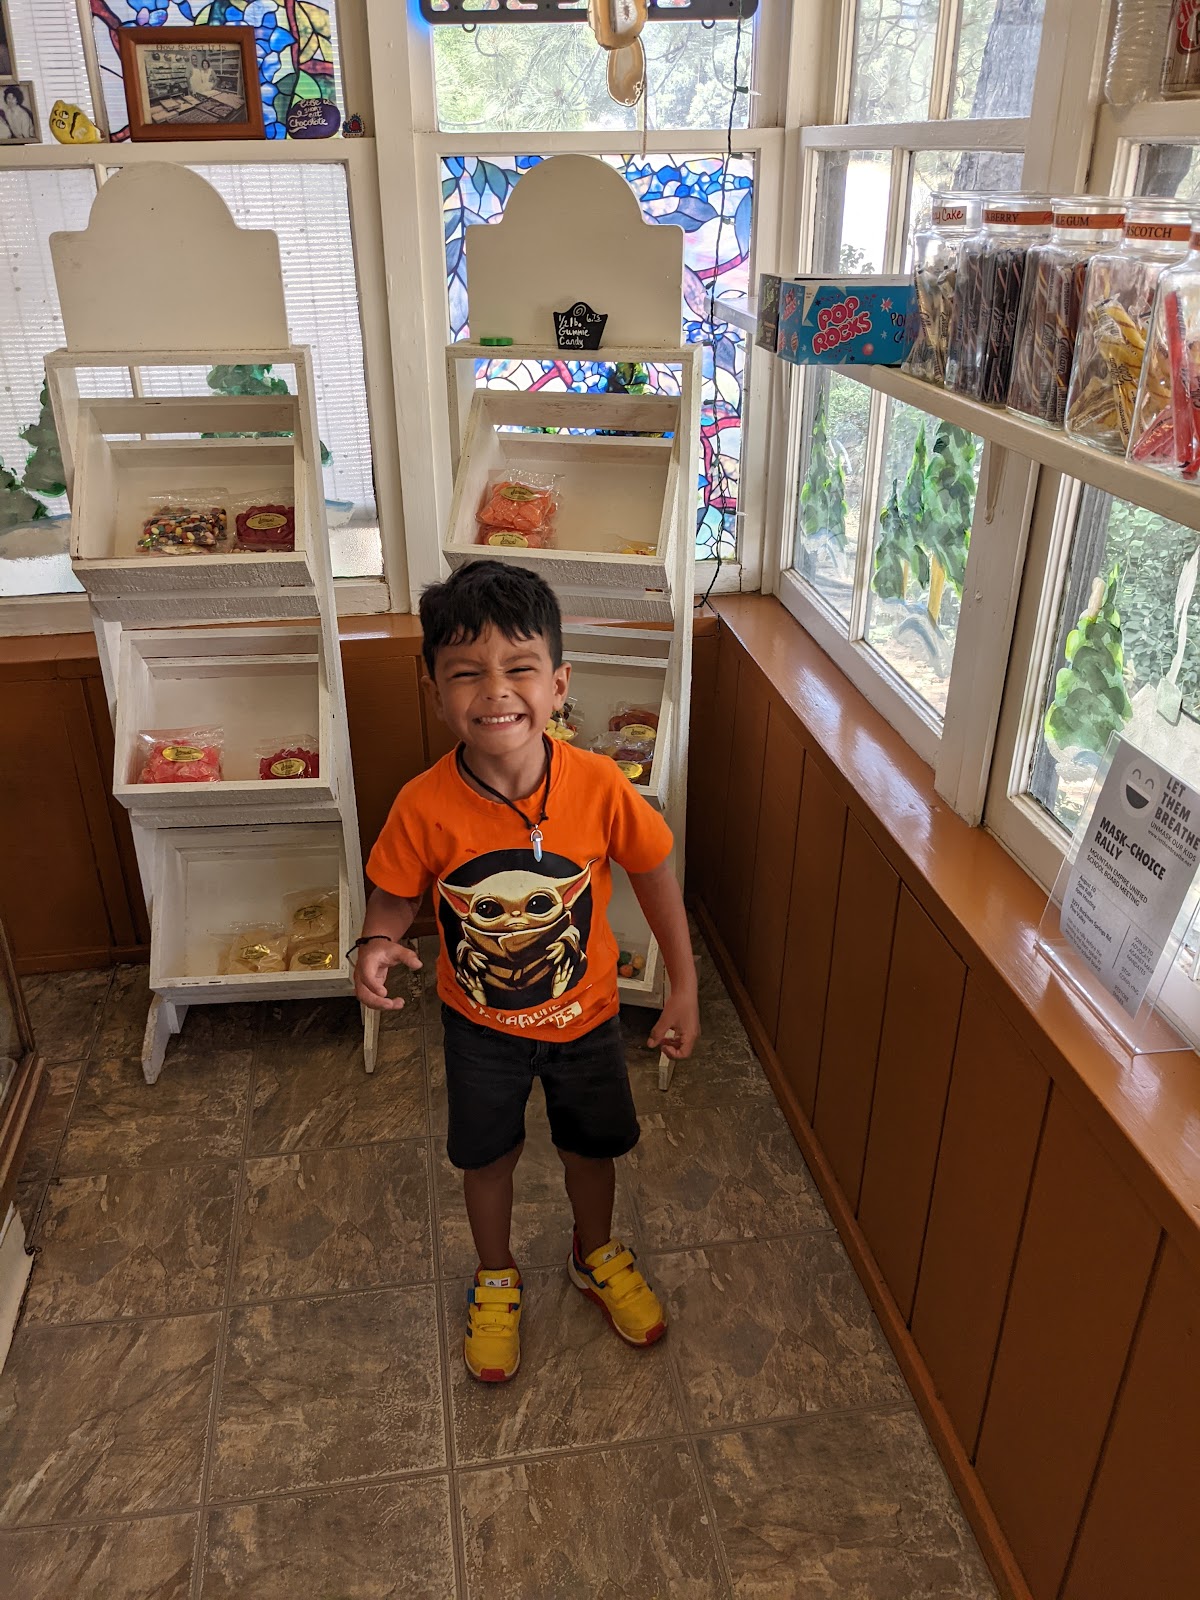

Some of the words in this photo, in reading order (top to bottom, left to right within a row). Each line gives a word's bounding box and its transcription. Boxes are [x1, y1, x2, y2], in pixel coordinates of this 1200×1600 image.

[289, 117, 328, 128] Chocolate
[942, 208, 964, 222] Cake
[1066, 216, 1089, 226] GUM
[818, 296, 860, 332] POP
[558, 326, 591, 337] Gummie
[559, 336, 585, 349] Candy
[812, 311, 873, 355] ROCKS
[1166, 776, 1187, 798] LET
[1161, 791, 1191, 822] THEM
[1150, 821, 1173, 842] UNMASK
[1171, 839, 1184, 852] OUR
[1182, 848, 1197, 862] KIDS
[1154, 806, 1200, 851] BREATHE
[1094, 830, 1123, 860] RALLY
[1100, 816, 1166, 881] MASK-CHOICE
[1086, 854, 1104, 874] SCHOOL
[1103, 870, 1120, 888] BOARD
[1119, 885, 1140, 907] MEETING
[1089, 847, 1114, 873] MOUNTAIN
[1112, 868, 1130, 887] EMPIRE
[1129, 883, 1148, 904] UNIFIED
